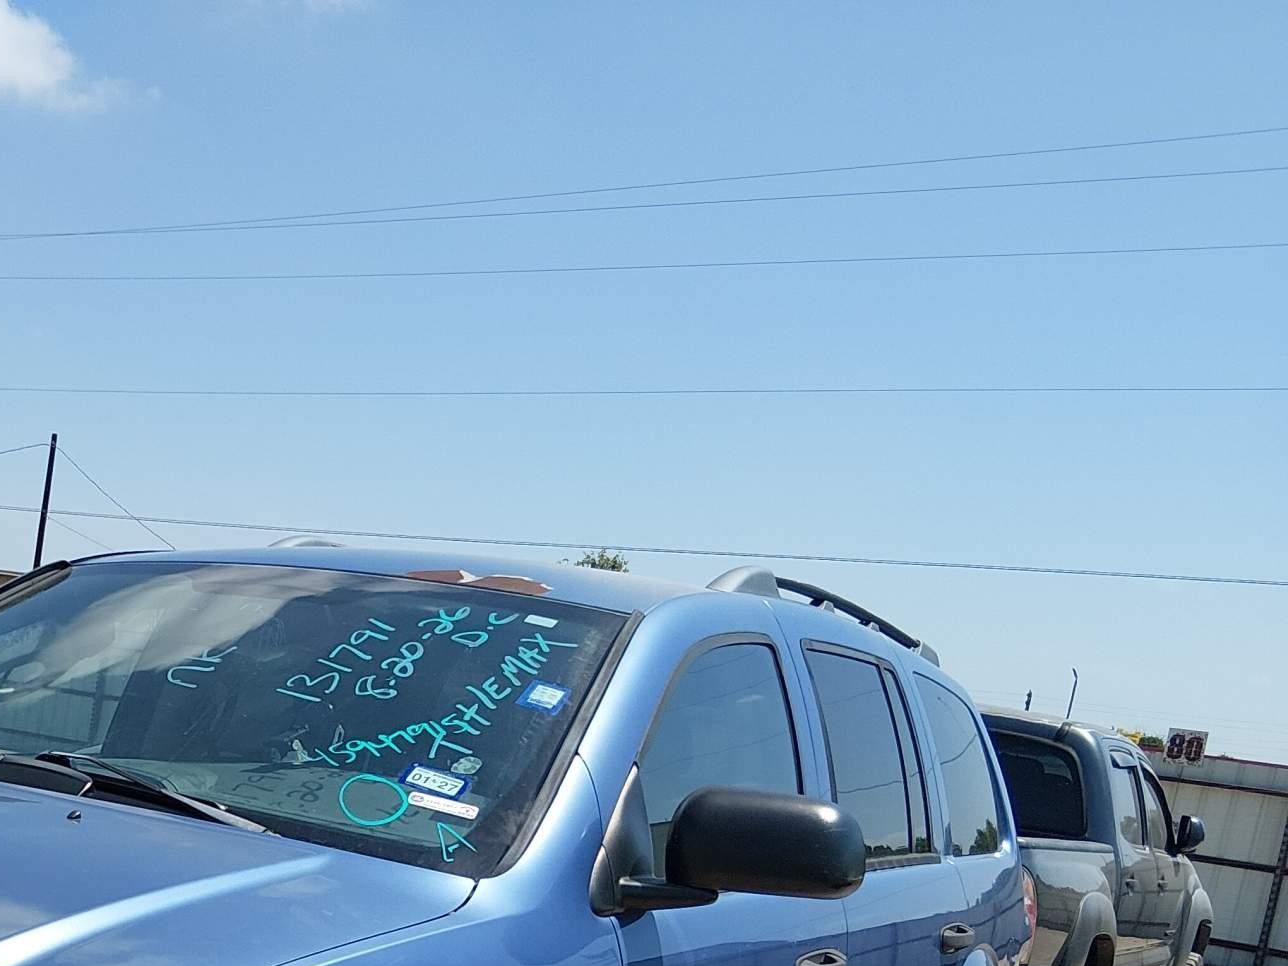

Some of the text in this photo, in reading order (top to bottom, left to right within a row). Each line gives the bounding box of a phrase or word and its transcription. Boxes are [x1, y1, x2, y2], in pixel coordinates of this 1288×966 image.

[275, 617, 397, 703] 131791
[1166, 734, 1203, 761] 80
[412, 773, 459, 792] 01 27
